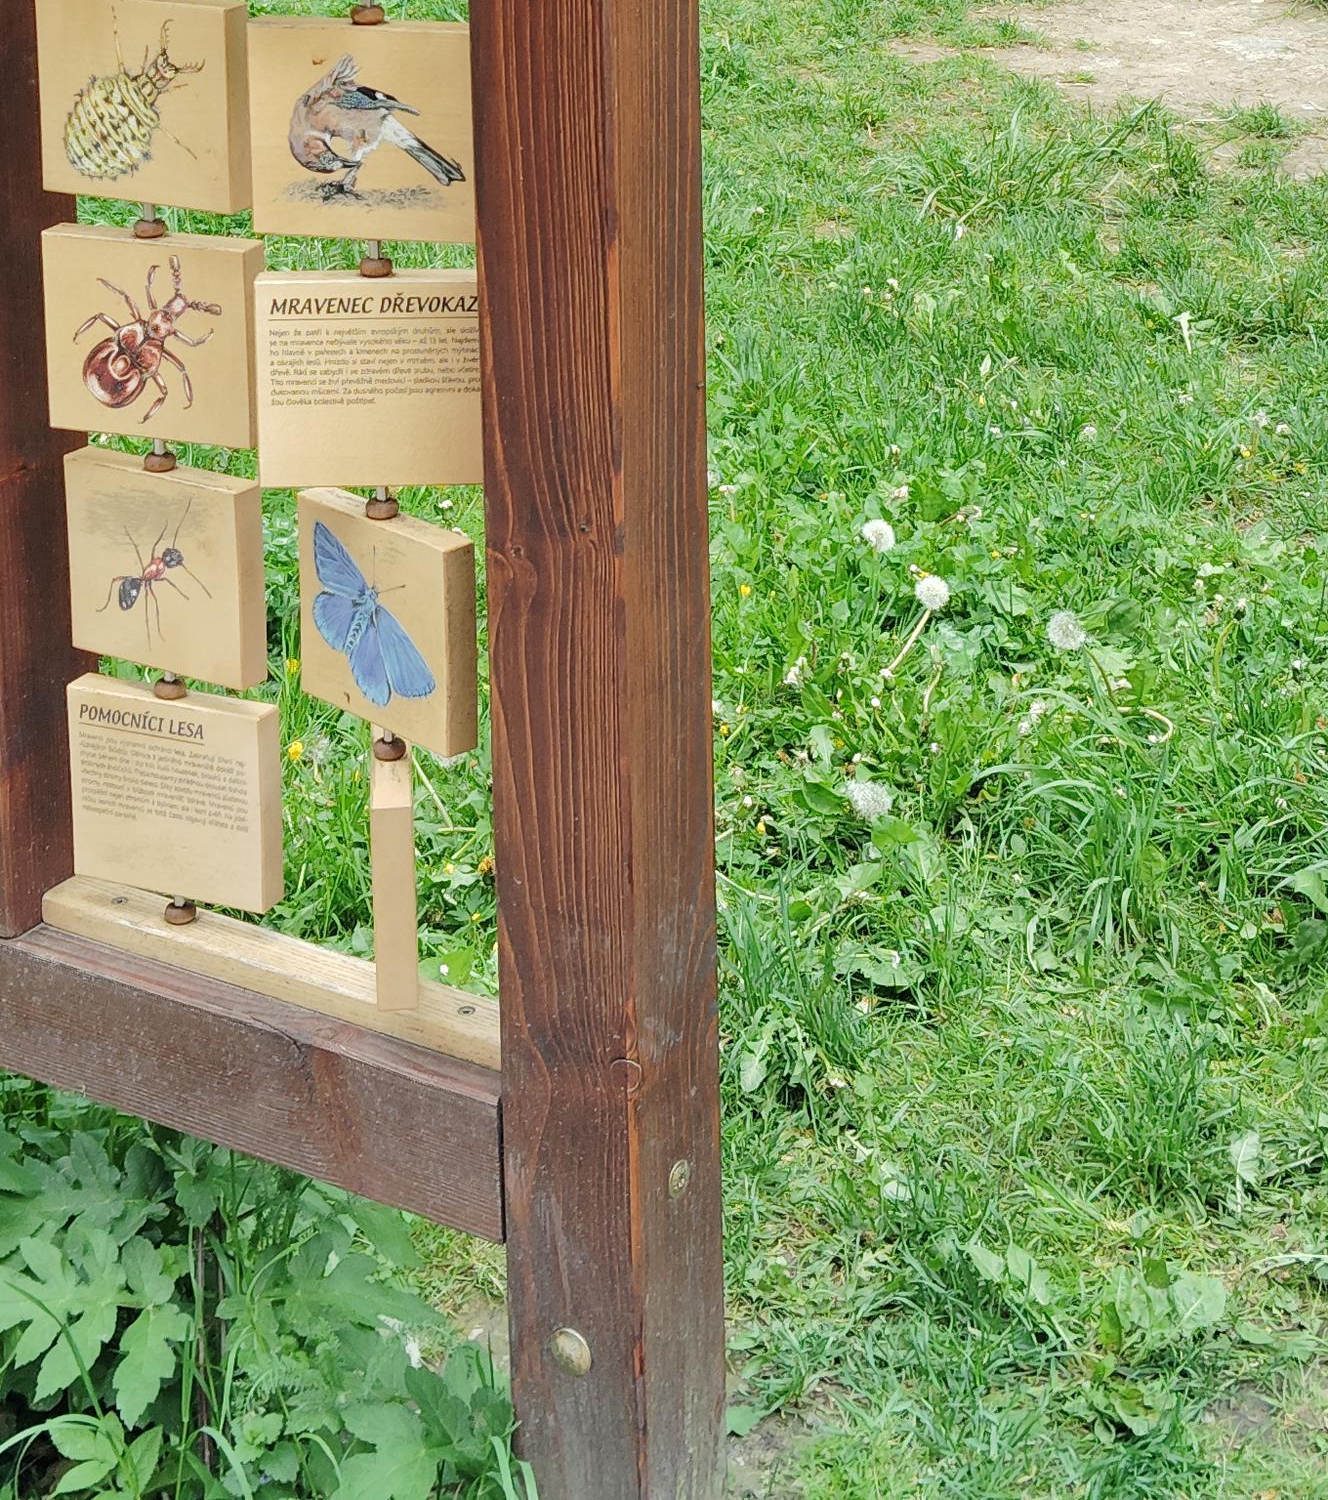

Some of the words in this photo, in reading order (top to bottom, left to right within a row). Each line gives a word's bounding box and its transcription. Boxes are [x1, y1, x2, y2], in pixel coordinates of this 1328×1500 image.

[270, 296, 373, 315] MRAVENEC
[380, 292, 478, 312] DŘEVOKAZ
[79, 703, 164, 732] POMOCNÍCI
[169, 719, 204, 740] LESA
